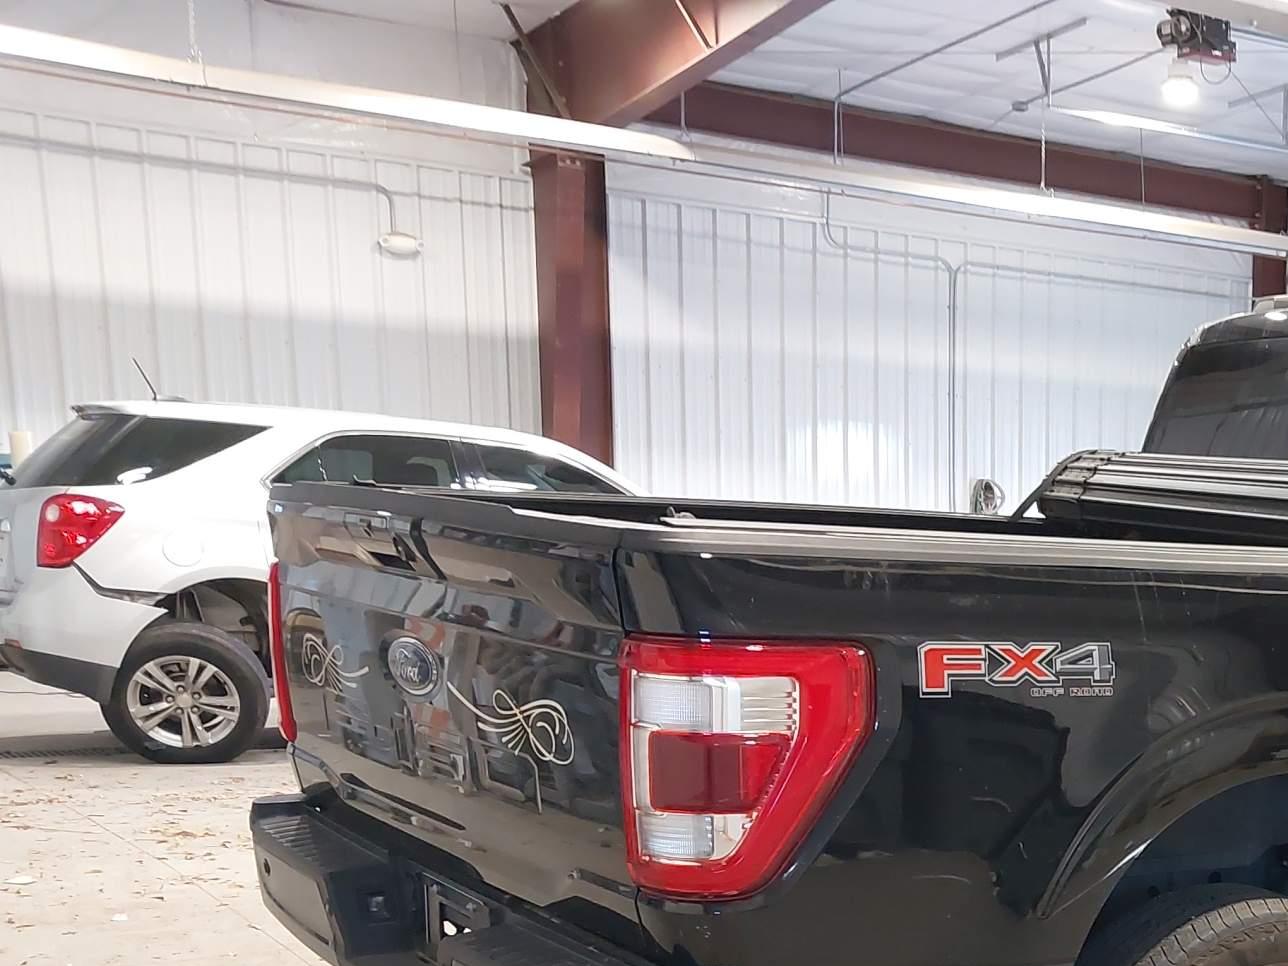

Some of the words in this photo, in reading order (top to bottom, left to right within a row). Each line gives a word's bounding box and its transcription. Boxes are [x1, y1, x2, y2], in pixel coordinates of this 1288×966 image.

[395, 647, 421, 684] Ford
[917, 641, 1115, 698] FX4
[1030, 687, 1065, 697] OFF
[1069, 687, 1114, 697] ROAD
